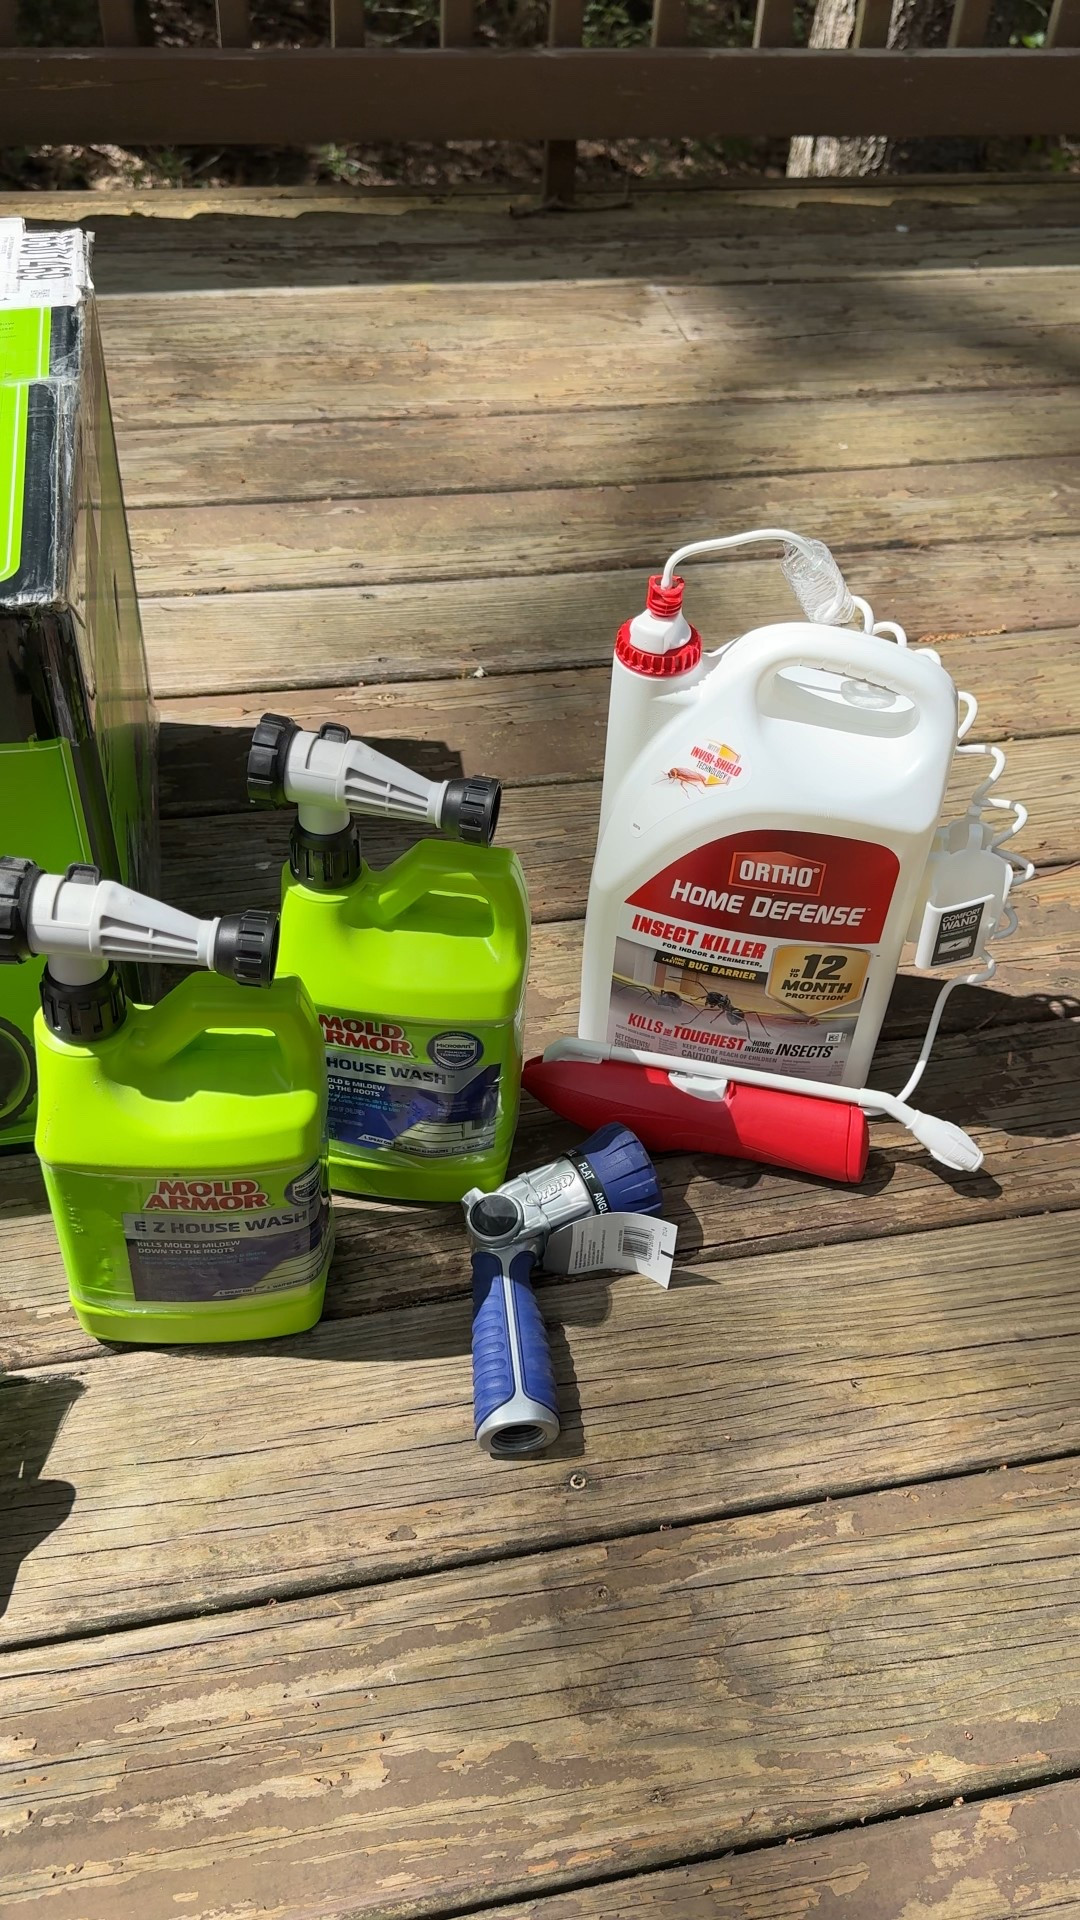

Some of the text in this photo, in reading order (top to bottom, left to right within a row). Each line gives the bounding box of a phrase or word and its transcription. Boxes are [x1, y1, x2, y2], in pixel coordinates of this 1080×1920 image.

[690, 745, 742, 777] INVISI-SHIELD
[696, 760, 728, 780] TECHNOLOGY
[670, 879, 866, 927] HOME DEFENSE
[942, 907, 982, 923] COMFORT
[942, 915, 978, 931] WAND
[631, 914, 767, 960] INSECT KILLER
[662, 942, 677, 950] FOR
[679, 946, 707, 958] INDOOR
[688, 961, 758, 980] BUG BARRIER
[801, 953, 848, 981] 12
[781, 979, 852, 994] MONTH
[785, 992, 844, 1001] PROTECTION
[319, 1014, 402, 1040] MOLD
[627, 1013, 664, 1034] KILLS
[673, 1025, 747, 1051] TOUGHEST
[325, 1029, 411, 1056] RMOR
[615, 1032, 625, 1041] NET
[752, 1040, 772, 1048] HOME
[681, 1049, 718, 1063] CAUTION
[682, 1042, 697, 1052] KEEP
[698, 1046, 709, 1054] OUT
[719, 1051, 740, 1059] REACH
[748, 1055, 778, 1063] CHILDREN
[744, 1045, 775, 1055] INVADING
[775, 1043, 833, 1058] INSECTS
[326, 1057, 386, 1076] HOUSE
[328, 1077, 343, 1085] OLD
[352, 1081, 386, 1092] MILDEW
[353, 1088, 380, 1097] ROOTS
[578, 1162, 595, 1180] FLAT
[158, 1181, 257, 1198] MOLD
[144, 1194, 268, 1211] ARMOR
[593, 1192, 609, 1216] ANGL
[171, 1222, 240, 1233] HOUSE
[244, 1210, 308, 1232] WASH
[201, 1240, 240, 1248] MILDEW
